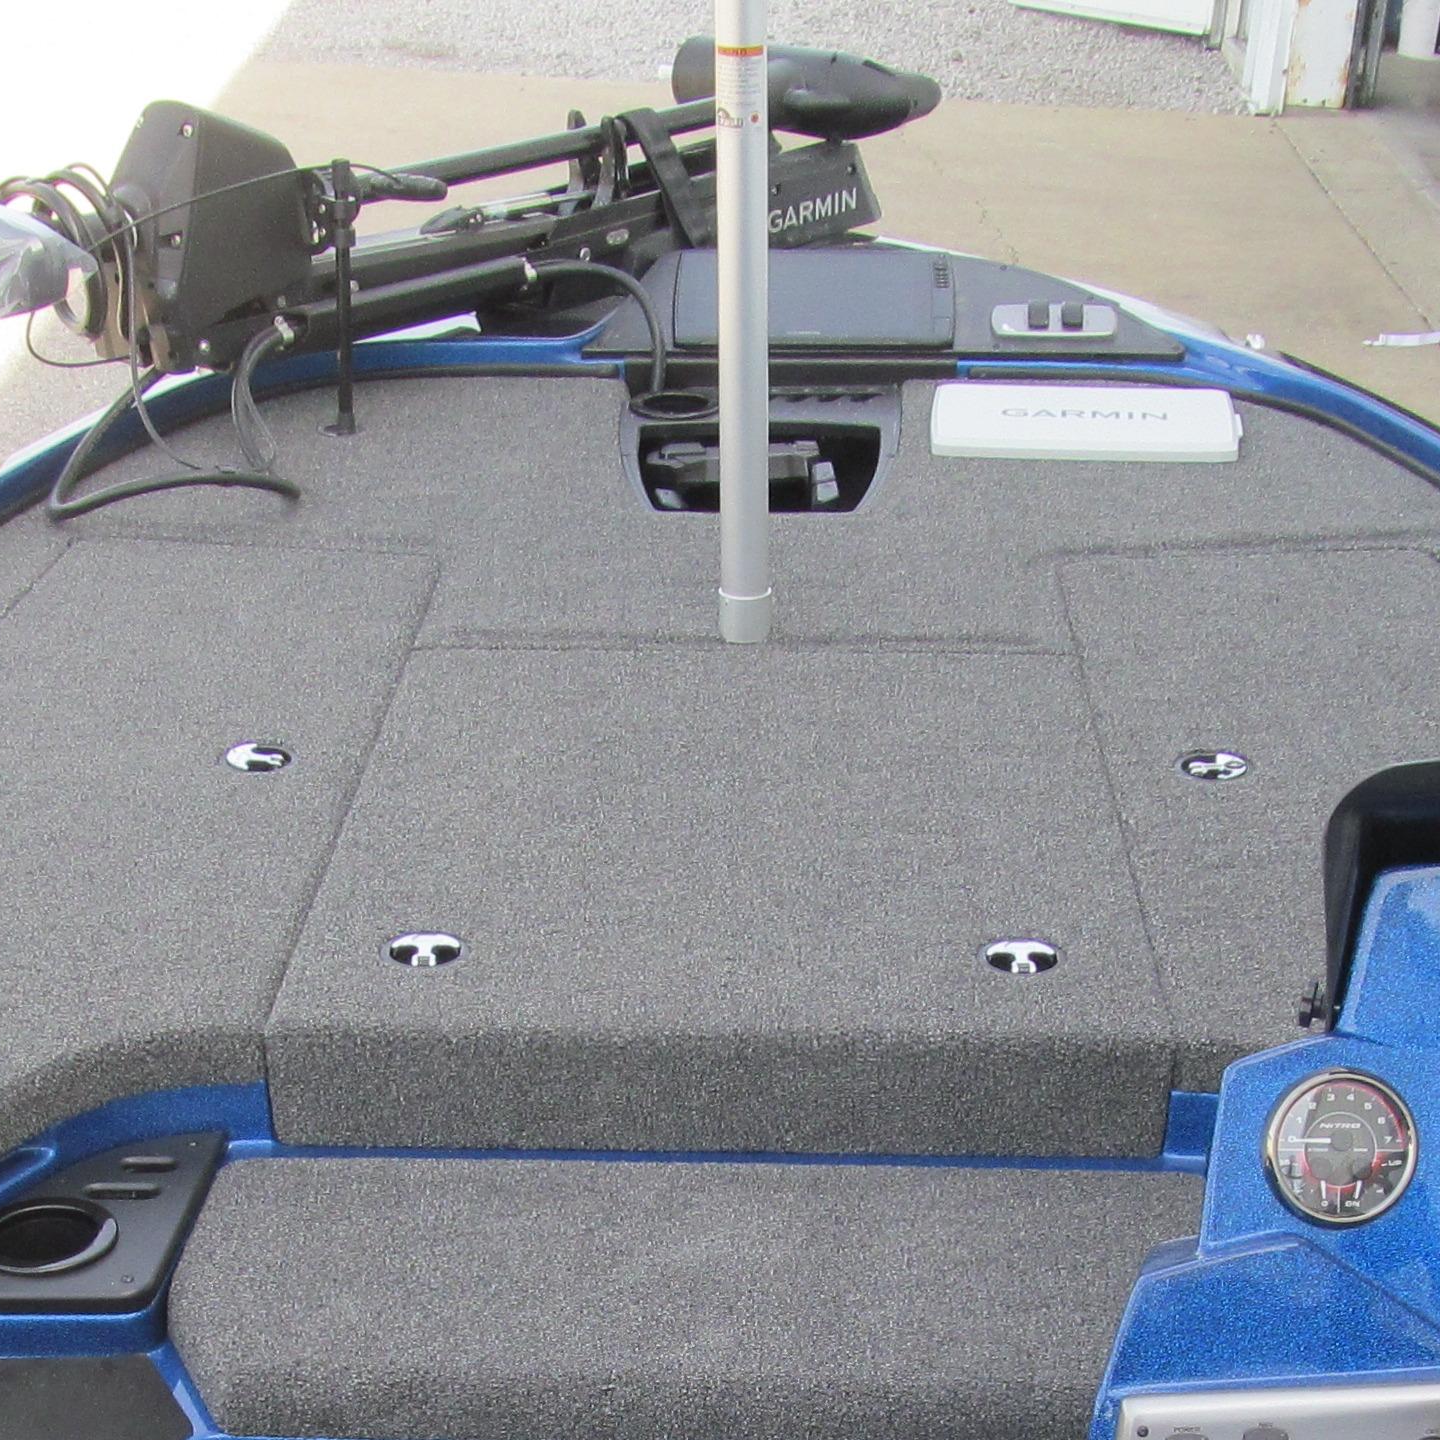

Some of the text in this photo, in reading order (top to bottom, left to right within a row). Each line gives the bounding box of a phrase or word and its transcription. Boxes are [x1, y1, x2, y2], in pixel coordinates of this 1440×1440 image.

[768, 187, 857, 234] GARMIN
[1001, 408, 1168, 421] GARMIN
[1326, 1093, 1336, 1101] 3
[1346, 1093, 1355, 1101] 4
[1364, 1102, 1372, 1110] 5
[1377, 1116, 1386, 1125] 6
[1383, 1136, 1393, 1144] 7
